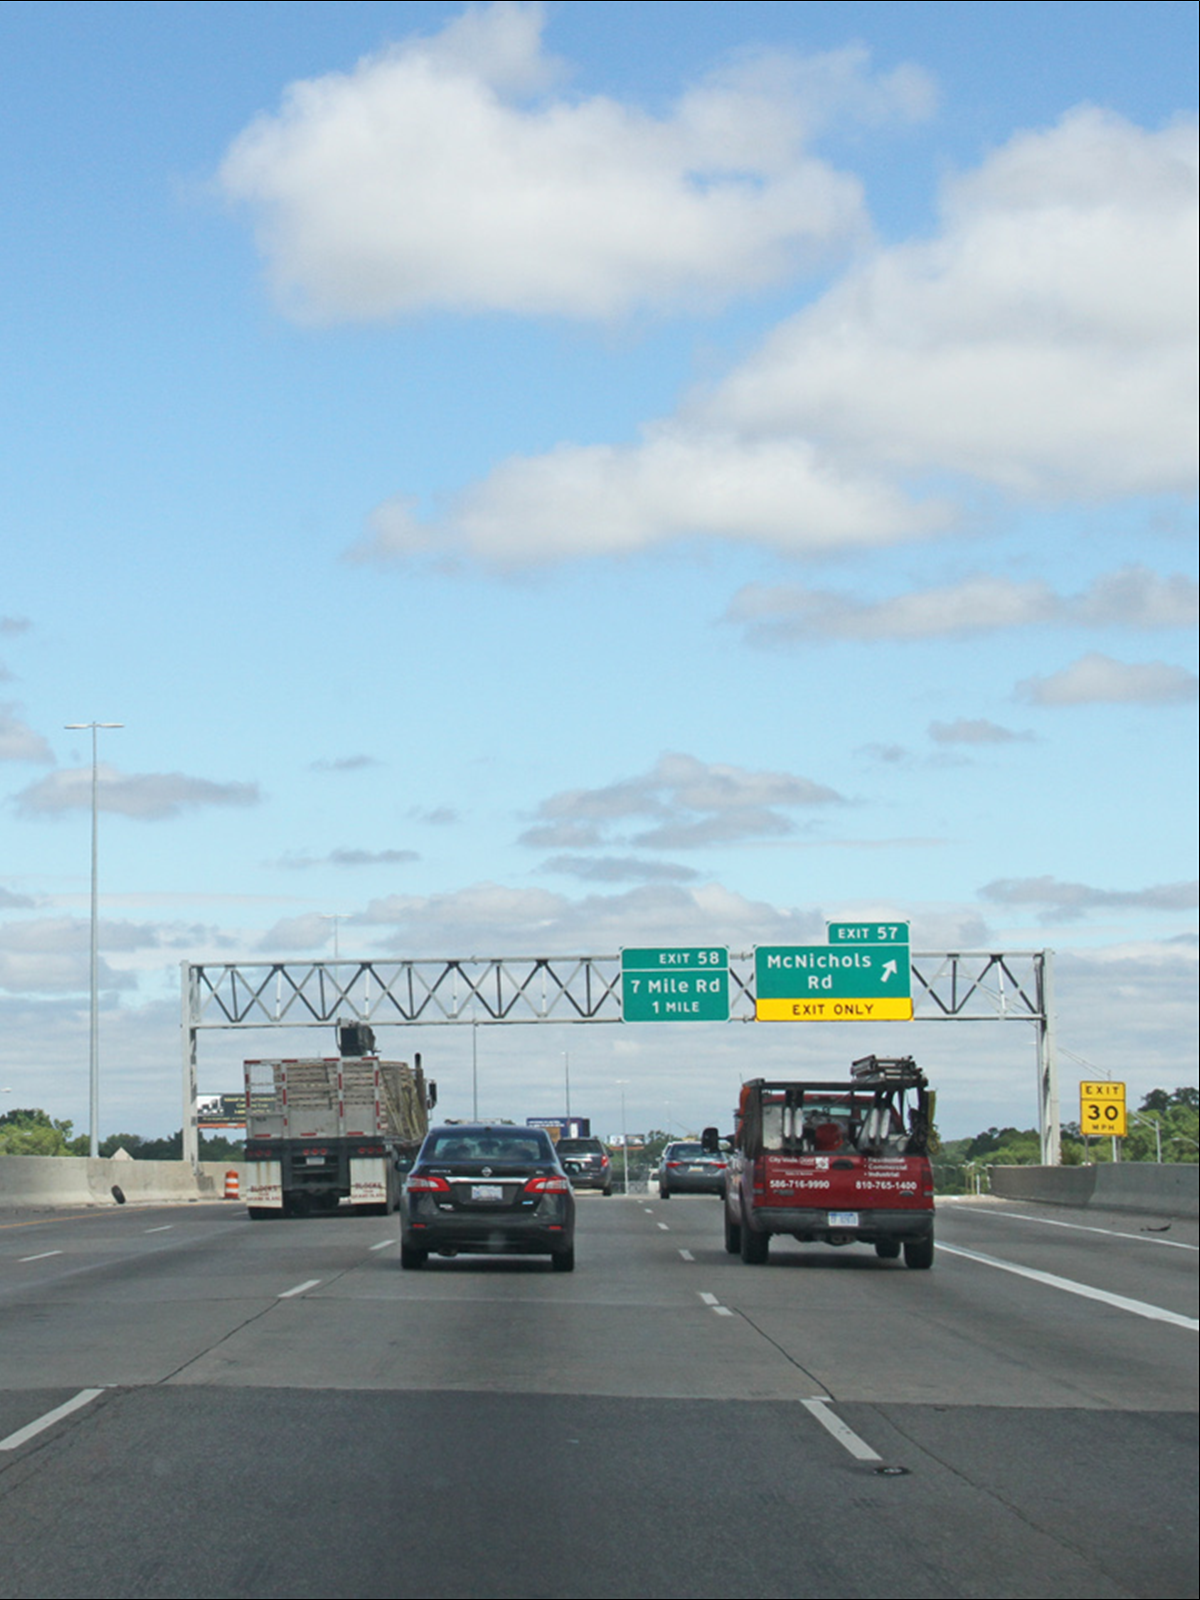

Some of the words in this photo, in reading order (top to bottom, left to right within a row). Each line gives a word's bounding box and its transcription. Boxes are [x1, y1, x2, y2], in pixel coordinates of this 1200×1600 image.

[838, 928, 869, 939] EXIT
[877, 926, 898, 940] 57
[659, 953, 690, 964] EXIT
[697, 951, 719, 965] 58
[767, 953, 872, 968] McNichols
[630, 980, 641, 993] 7
[648, 978, 689, 993] Mile
[696, 978, 720, 993] Rd
[808, 974, 833, 989] Rd
[652, 1001, 659, 1014] 1
[666, 1001, 699, 1013] MILE
[792, 1004, 825, 1016] EXIT
[833, 1003, 874, 1015] ONLY
[1085, 1085, 1119, 1095] EXIT
[1087, 1104, 1119, 1121] 30
